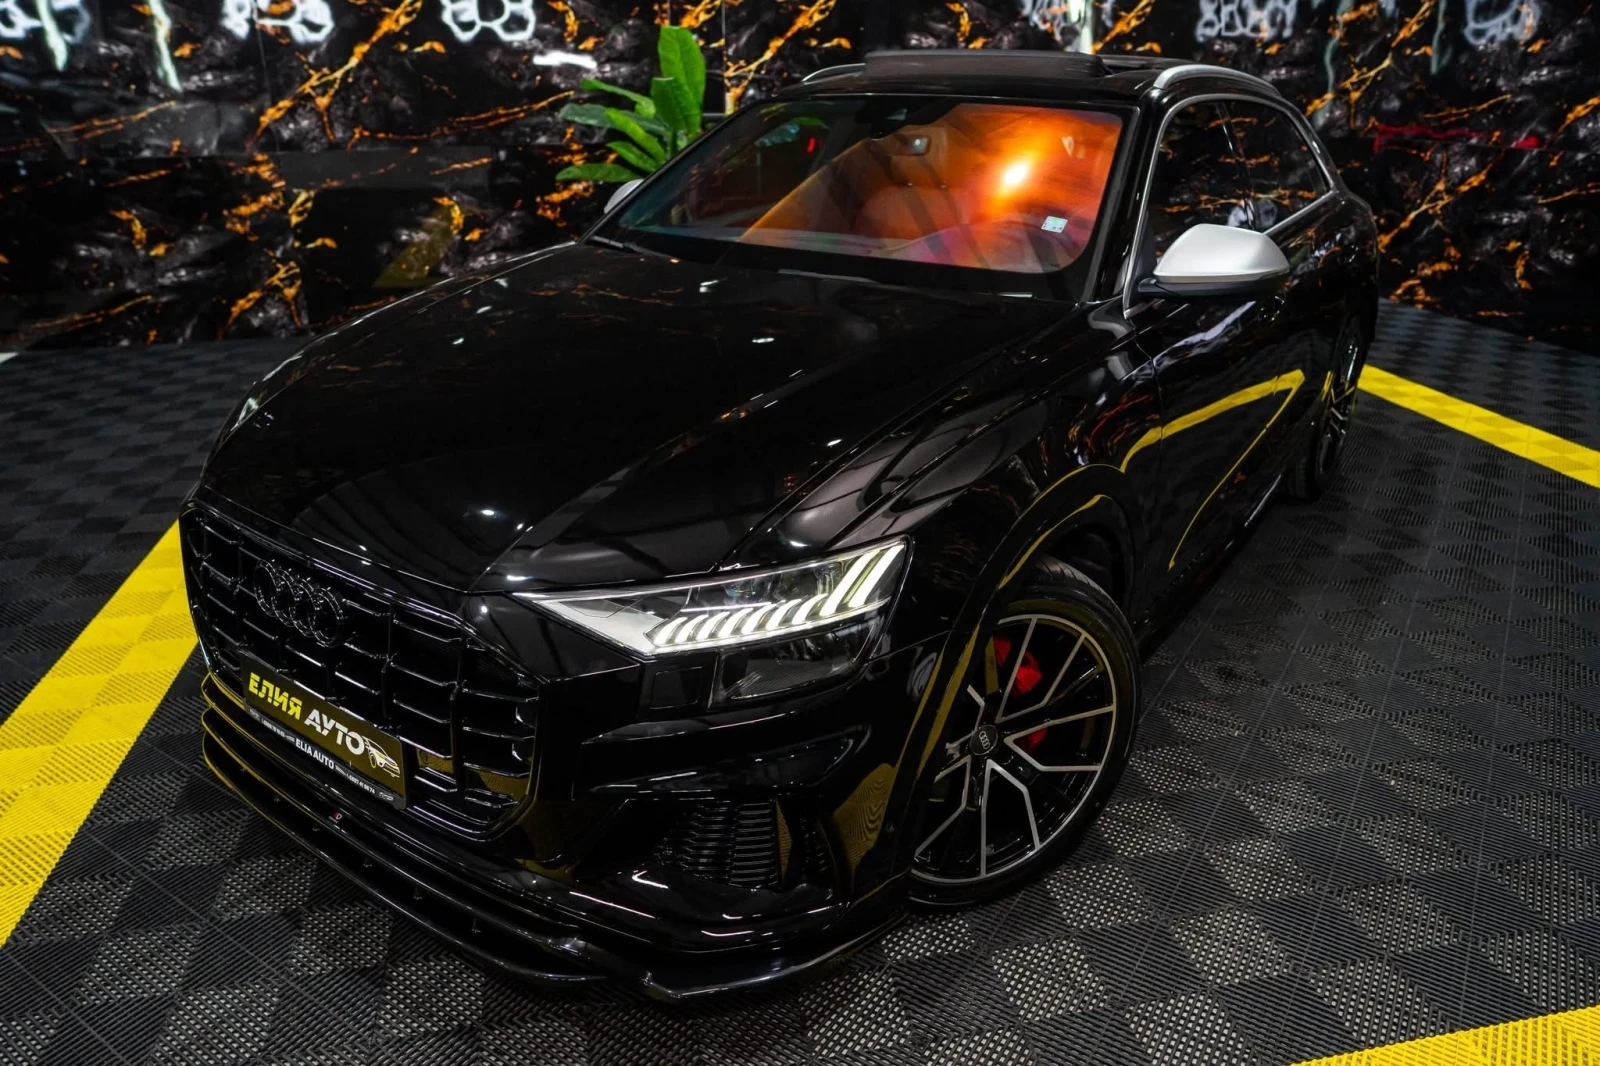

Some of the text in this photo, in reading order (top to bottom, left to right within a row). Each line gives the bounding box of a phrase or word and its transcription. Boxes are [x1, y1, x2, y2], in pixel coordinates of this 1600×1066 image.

[248, 671, 303, 720] ЕЛИЯ
[304, 708, 365, 755] АУТО
[295, 738, 313, 756] ELIA
[313, 749, 335, 770] AUTO
